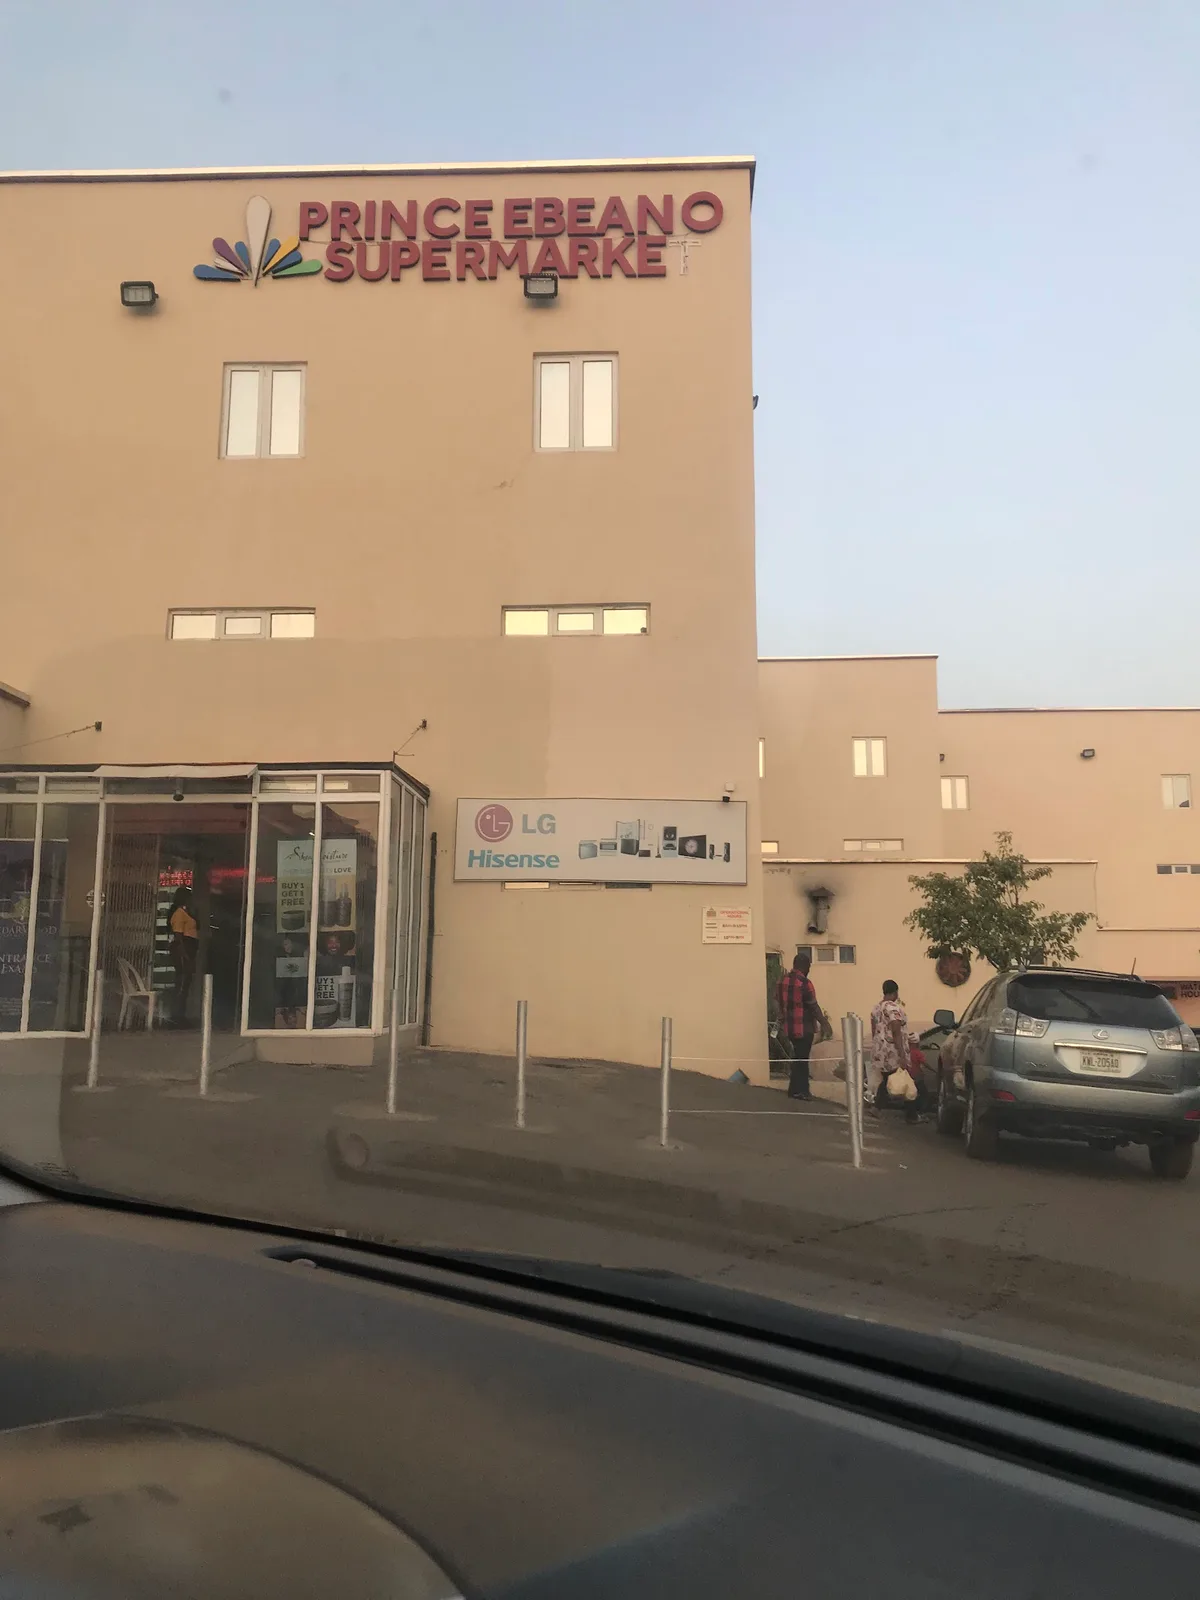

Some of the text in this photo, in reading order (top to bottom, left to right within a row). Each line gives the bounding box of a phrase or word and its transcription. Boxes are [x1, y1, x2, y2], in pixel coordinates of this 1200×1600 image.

[299, 191, 724, 241] PRINCE EBEANO
[324, 235, 702, 283] SUPERMARKET
[522, 813, 556, 834] LG
[467, 849, 560, 868] Hisense
[281, 898, 305, 906] FREE
